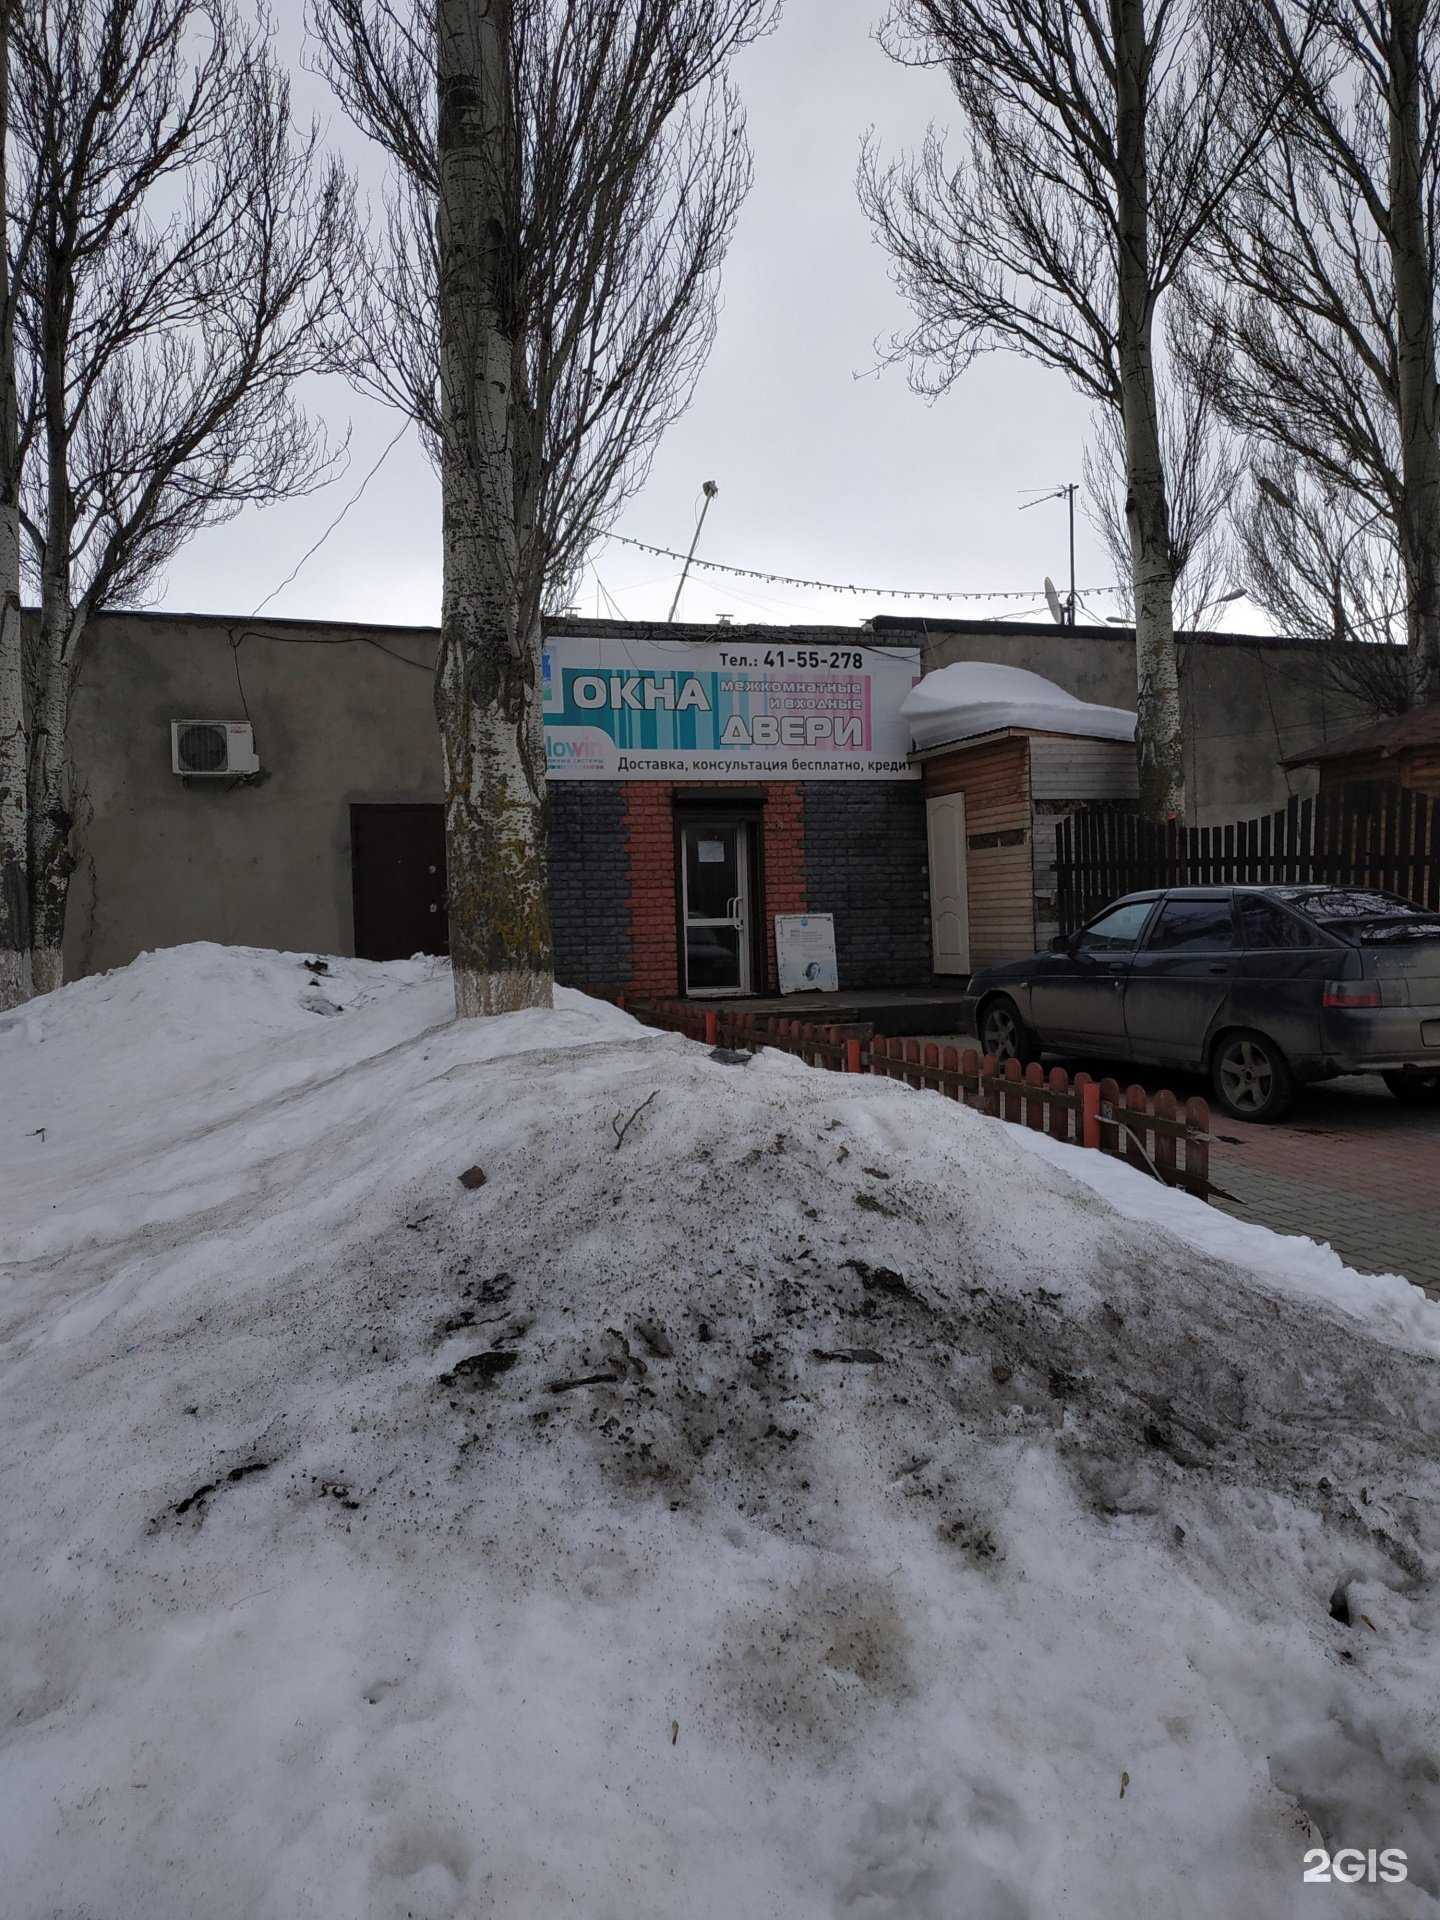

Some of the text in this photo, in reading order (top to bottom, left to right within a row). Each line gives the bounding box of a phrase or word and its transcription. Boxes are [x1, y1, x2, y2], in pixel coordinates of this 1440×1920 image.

[720, 651, 863, 669] Тел.: 41-55-278
[572, 675, 712, 711] ОКНА
[719, 680, 862, 693] межкомнатные
[770, 697, 862, 710] и входные
[719, 715, 863, 746] ДВЕРИ
[617, 757, 689, 772] Доставка,
[692, 760, 787, 772] консультация
[791, 758, 864, 772] бесплатно,
